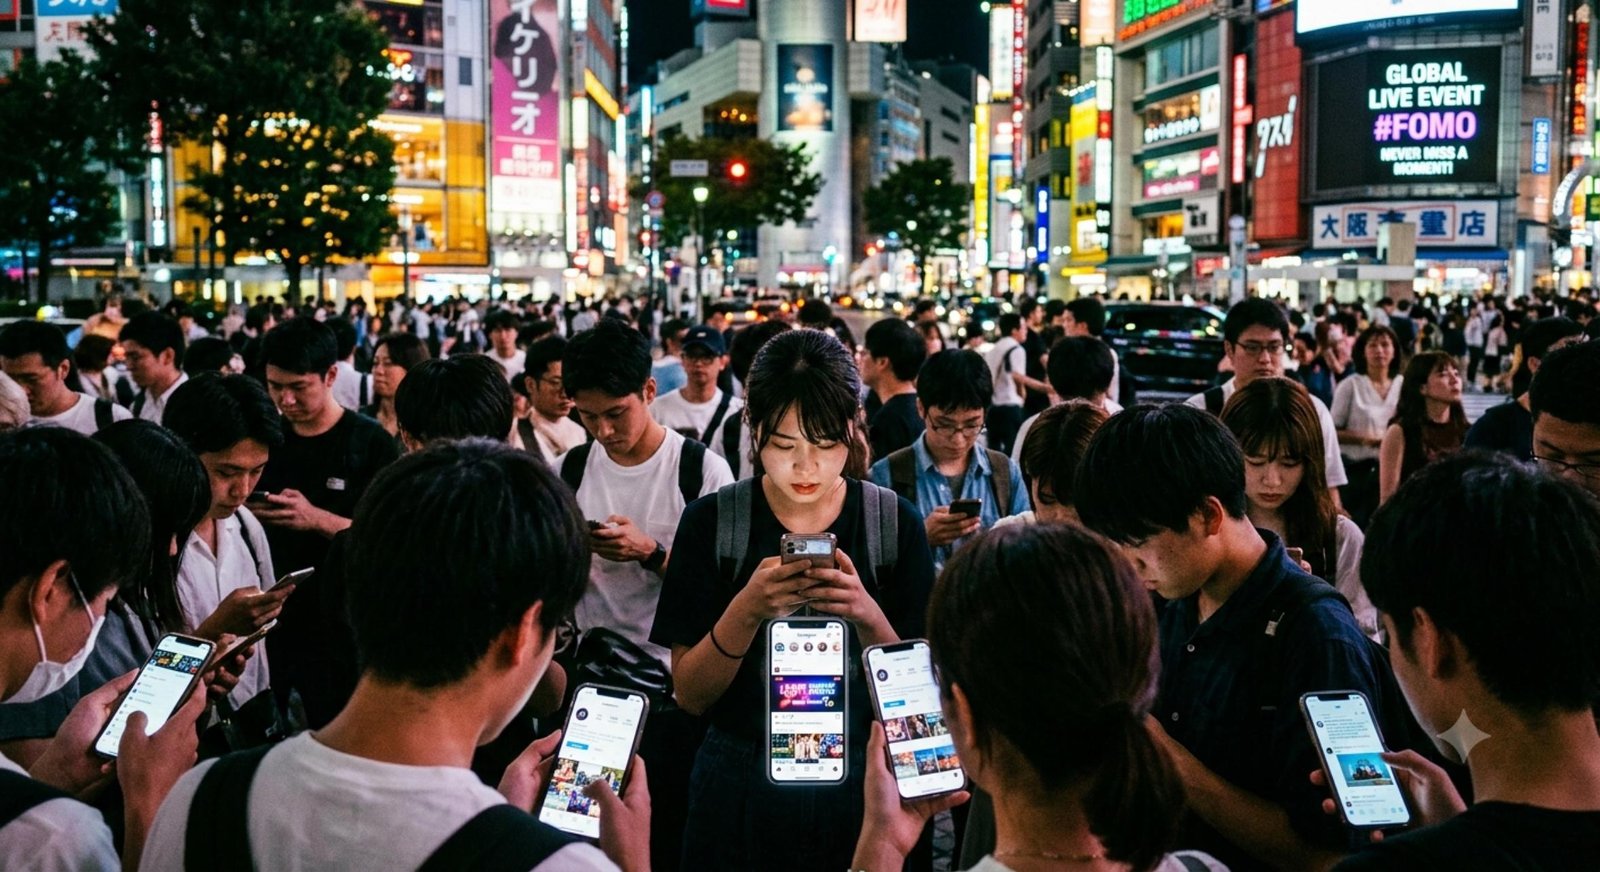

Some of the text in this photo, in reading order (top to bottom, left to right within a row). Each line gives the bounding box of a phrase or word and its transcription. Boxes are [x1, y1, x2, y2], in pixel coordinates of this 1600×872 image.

[1386, 61, 1468, 85] GLOBAL
[1368, 84, 1486, 110] LIVE EVENT
[1373, 110, 1477, 141] #FOMO
[1380, 145, 1469, 161] NEVER MISS A
